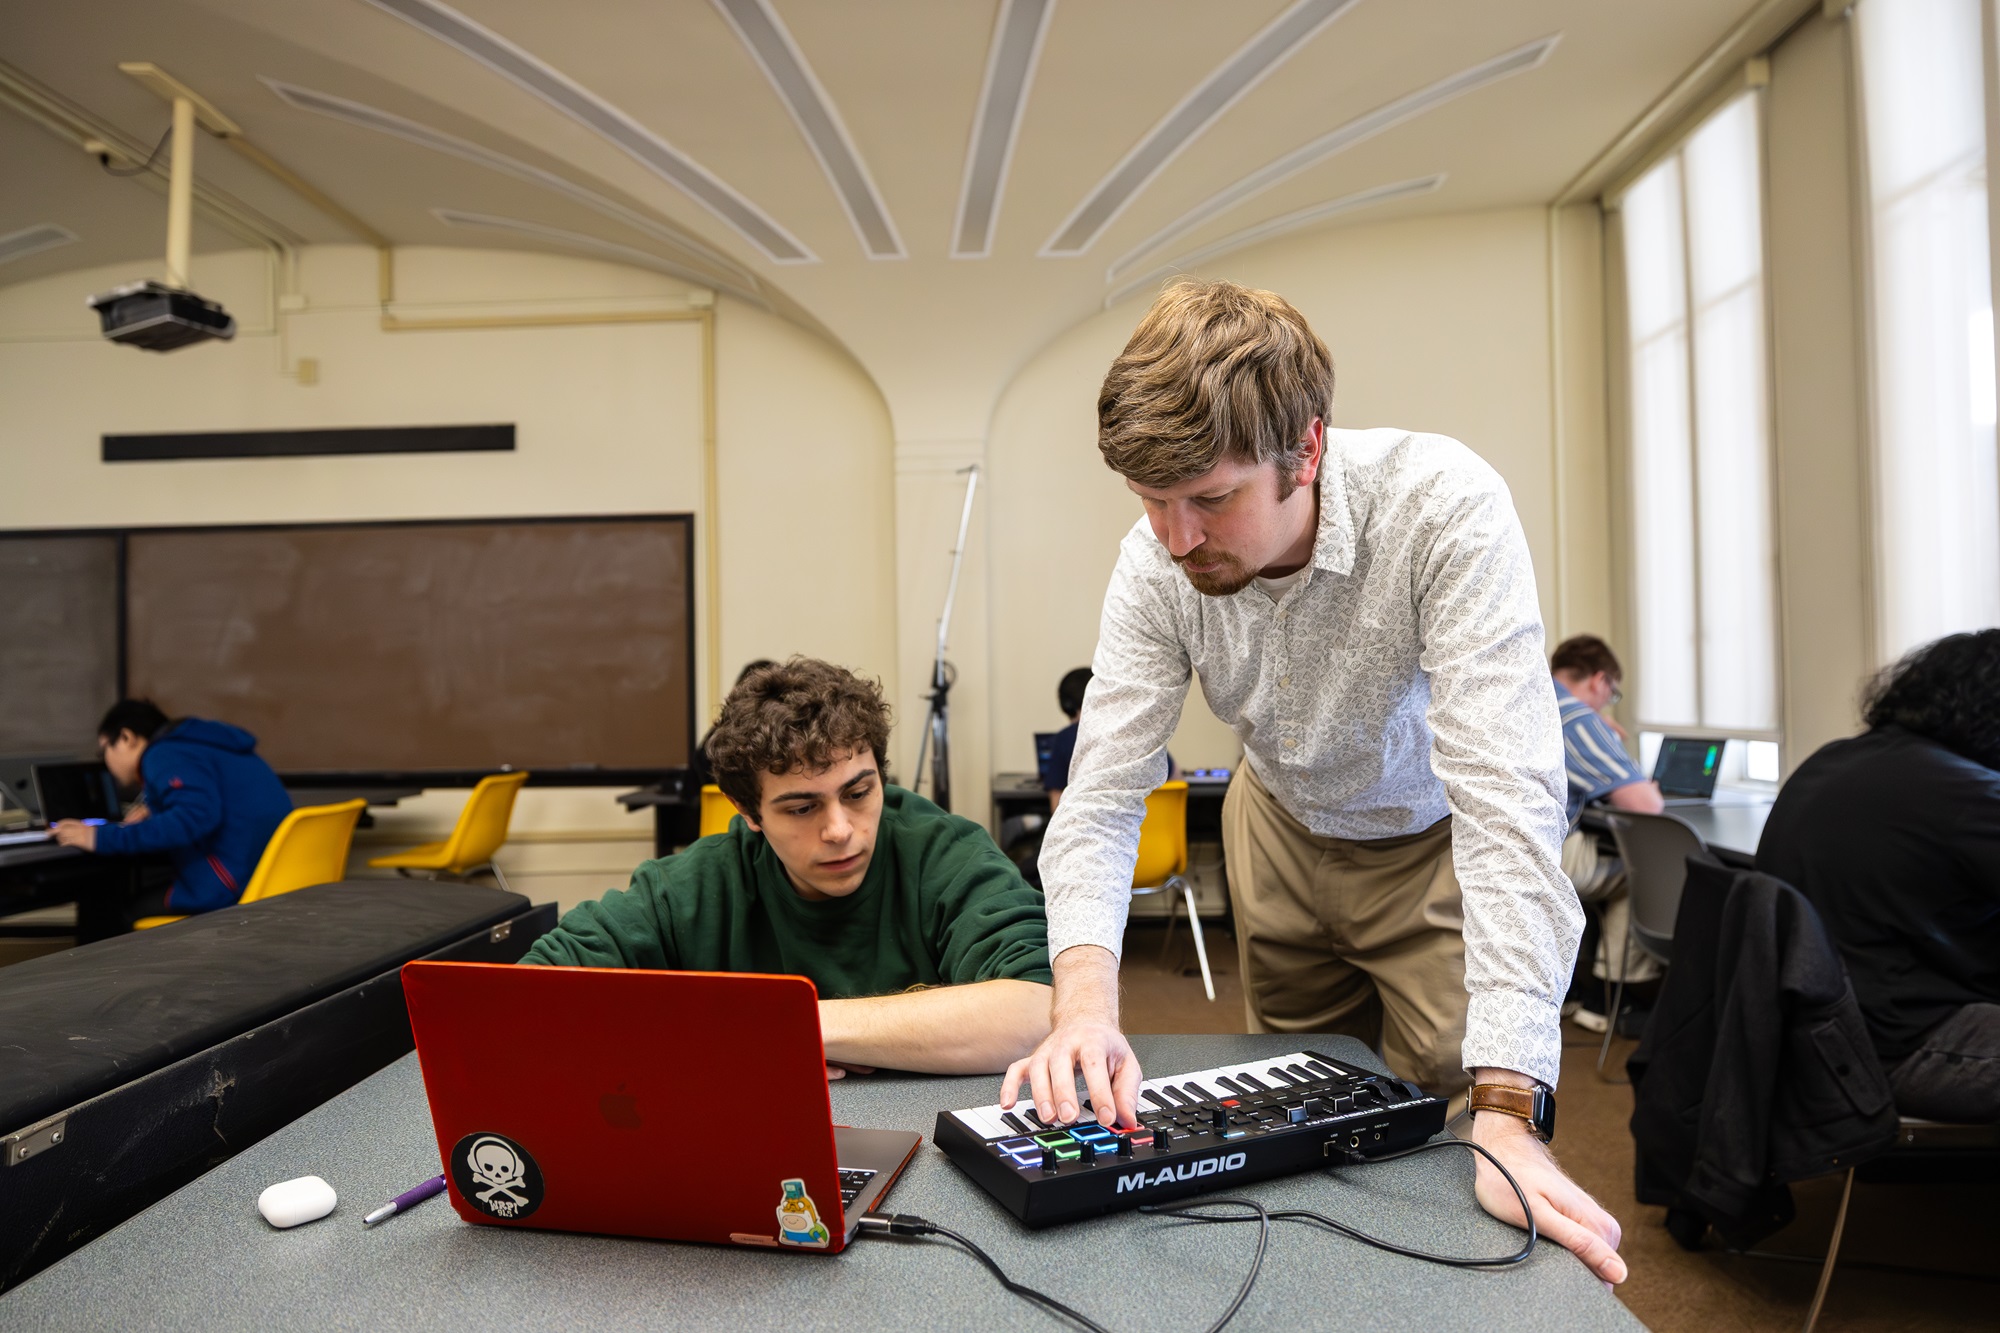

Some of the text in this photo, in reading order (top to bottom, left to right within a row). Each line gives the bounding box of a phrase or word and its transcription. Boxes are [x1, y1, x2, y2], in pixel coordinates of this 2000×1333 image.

[1387, 1097, 1436, 1110] M-AUDIO
[1116, 1152, 1247, 1193] M-AUDIO
[489, 1200, 518, 1214] WRPI
